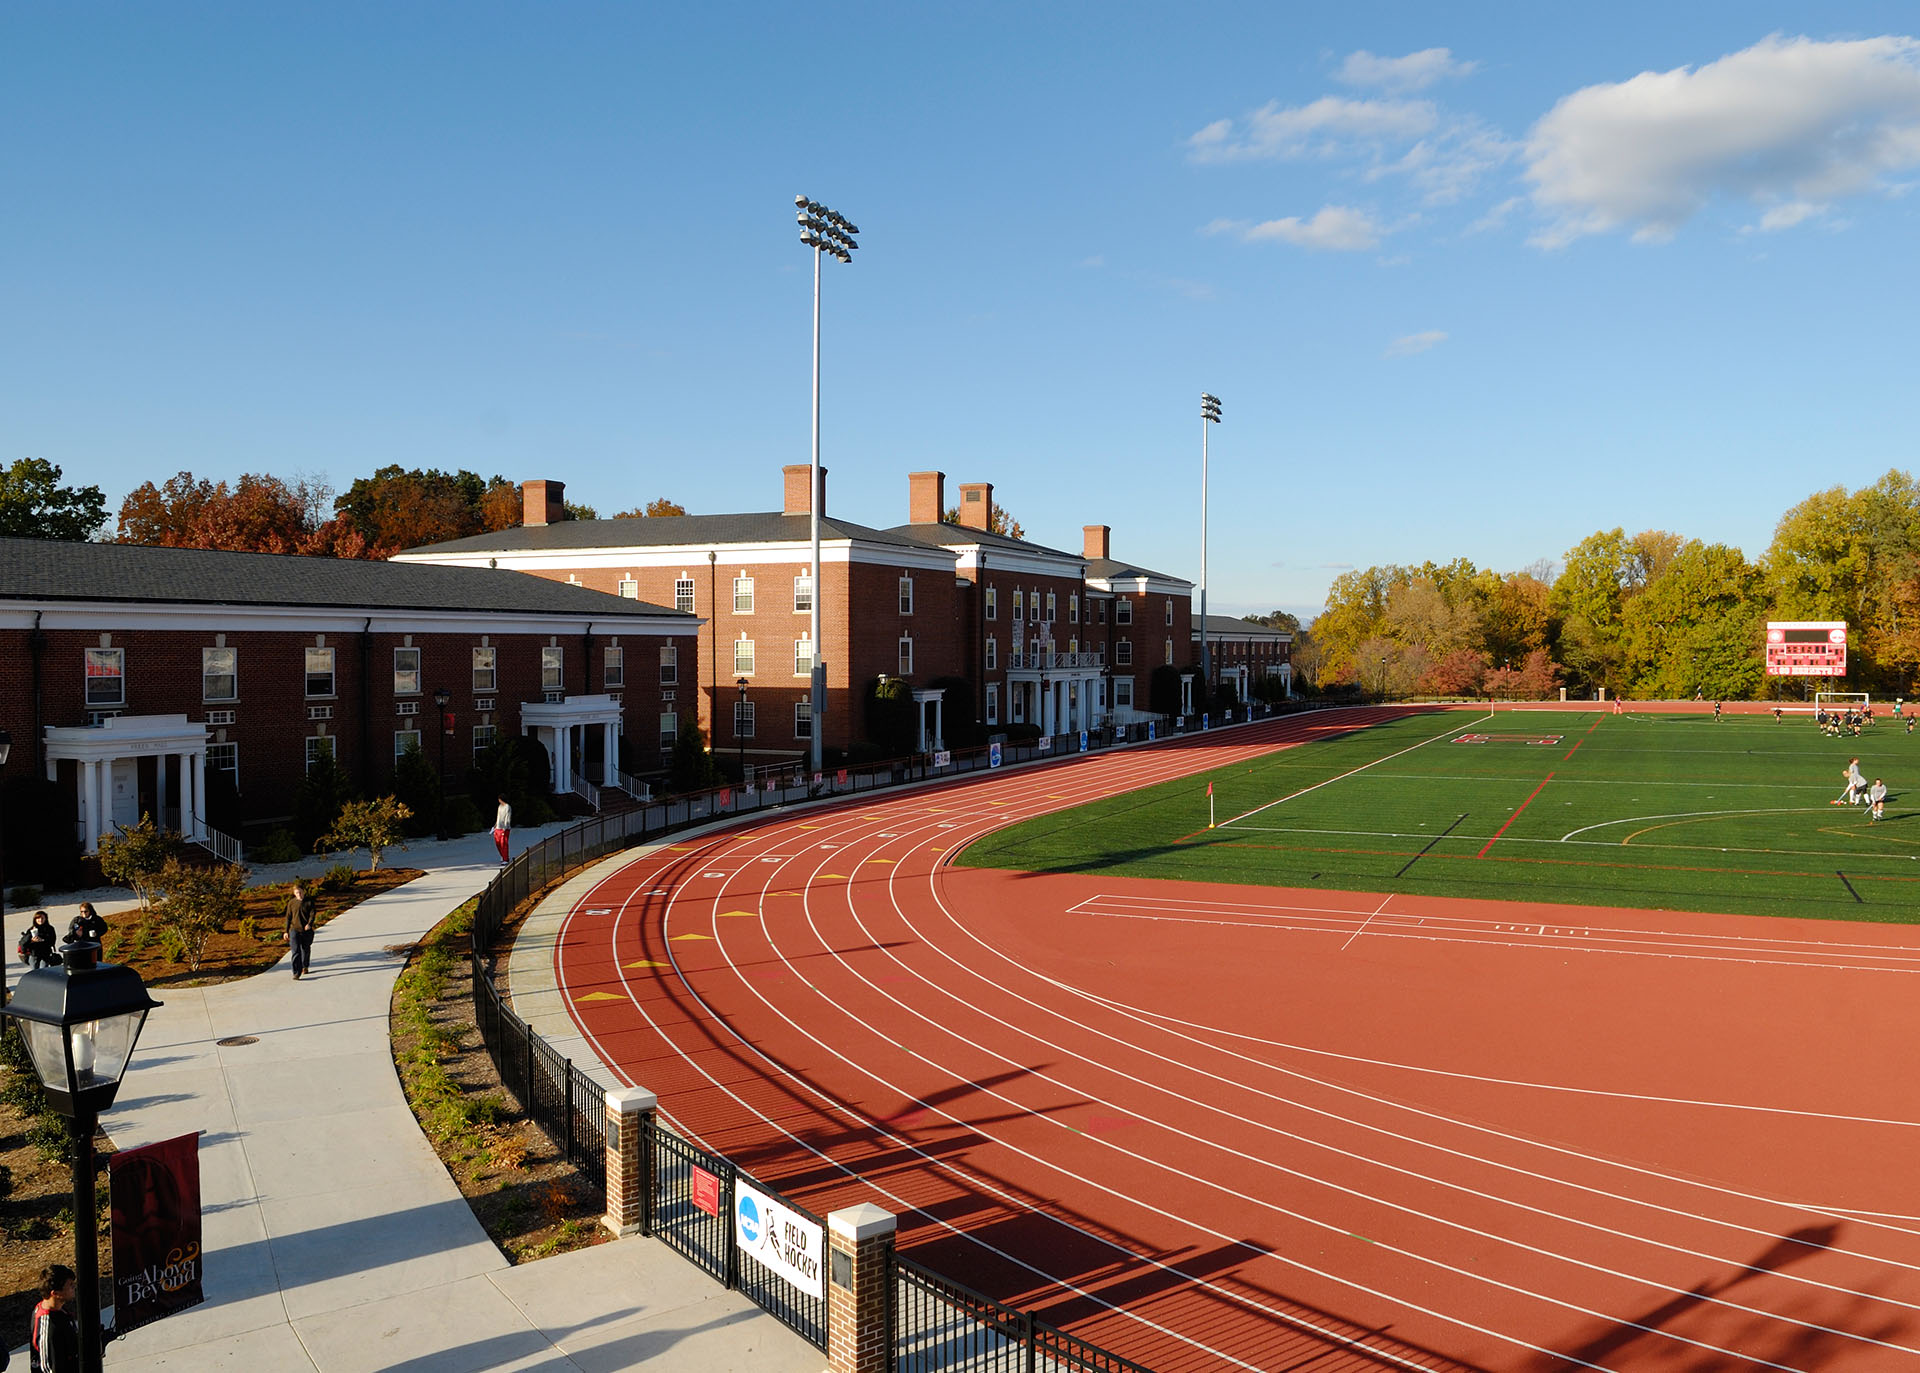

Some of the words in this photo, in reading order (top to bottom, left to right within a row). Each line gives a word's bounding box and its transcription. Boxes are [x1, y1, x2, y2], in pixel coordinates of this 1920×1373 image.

[784, 1220, 807, 1251] FIELD
[117, 1272, 143, 1287] Going
[142, 1259, 193, 1286] Above
[784, 1244, 818, 1281] HOCKEY
[127, 1260, 197, 1306] Beyond
